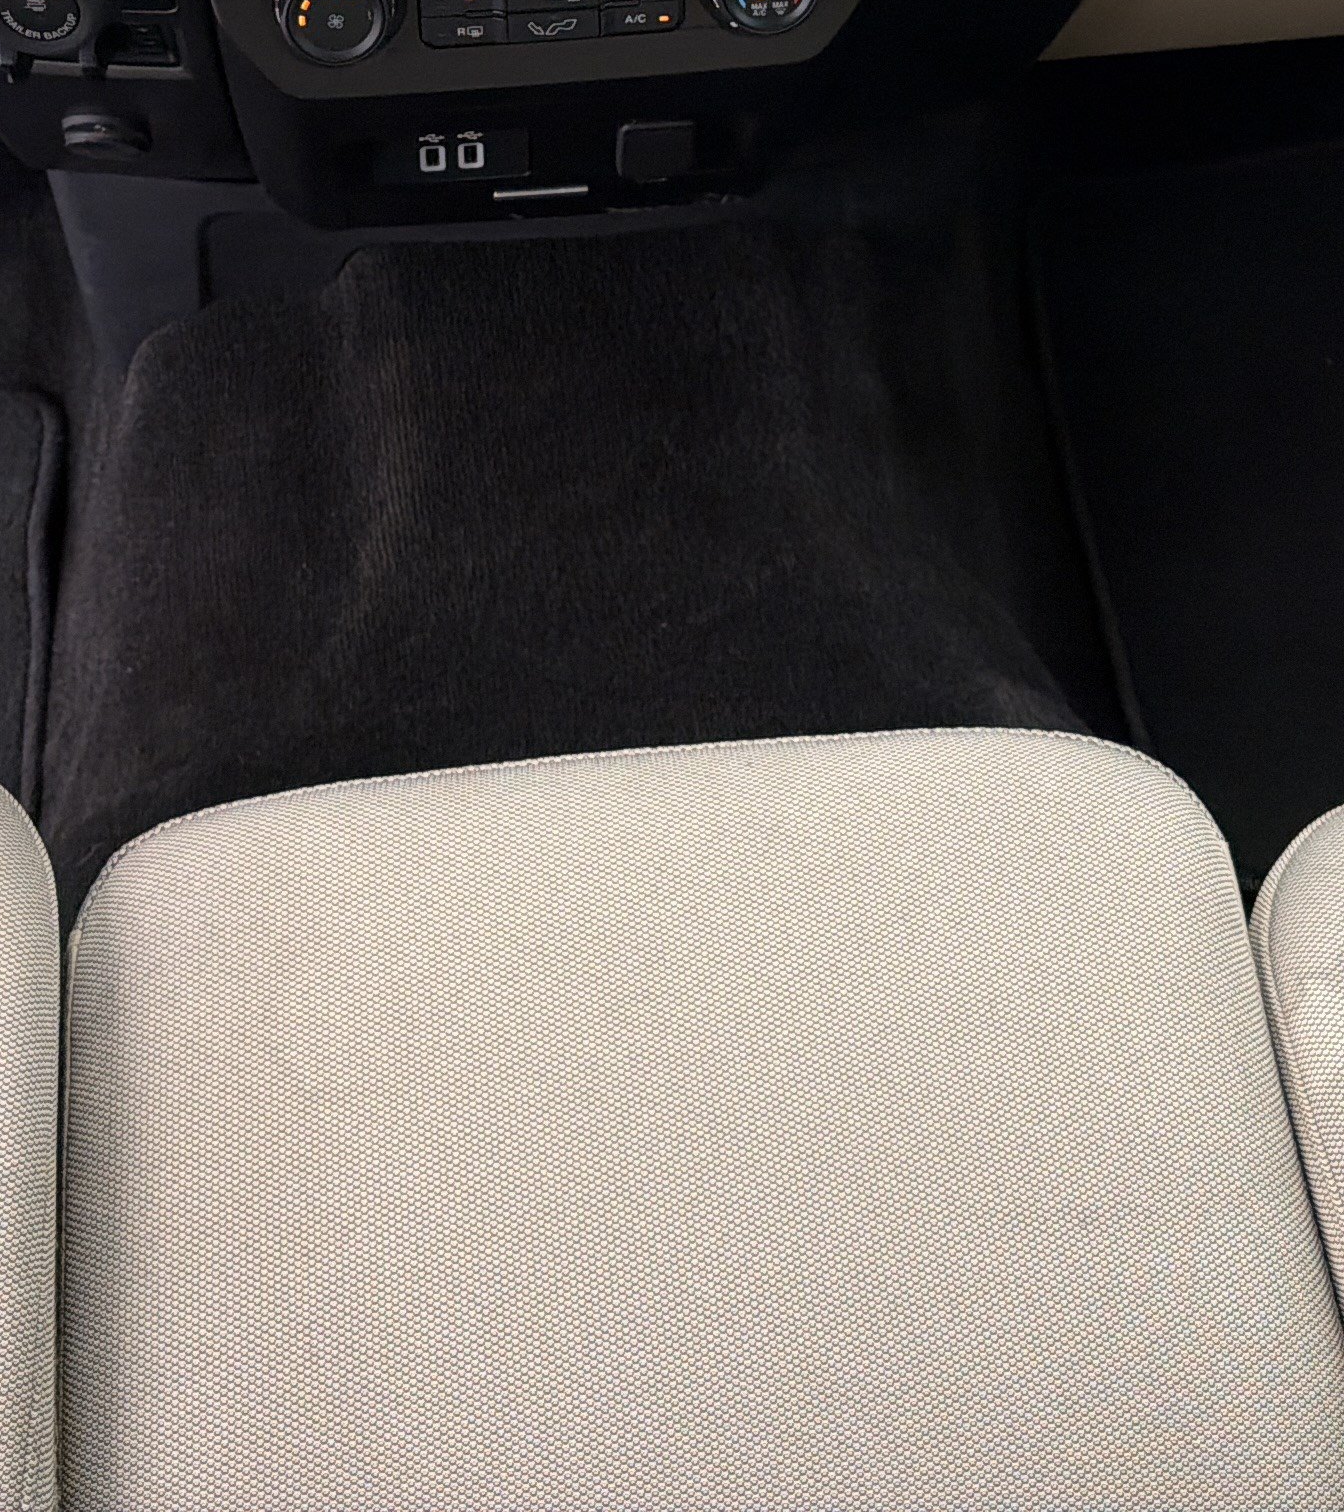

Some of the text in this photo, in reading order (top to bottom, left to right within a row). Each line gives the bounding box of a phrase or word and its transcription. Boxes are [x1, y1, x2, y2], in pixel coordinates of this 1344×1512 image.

[624, 13, 647, 24] A/C
[0, 9, 77, 40] TRAILER BACKUP
[457, 27, 466, 37] R
